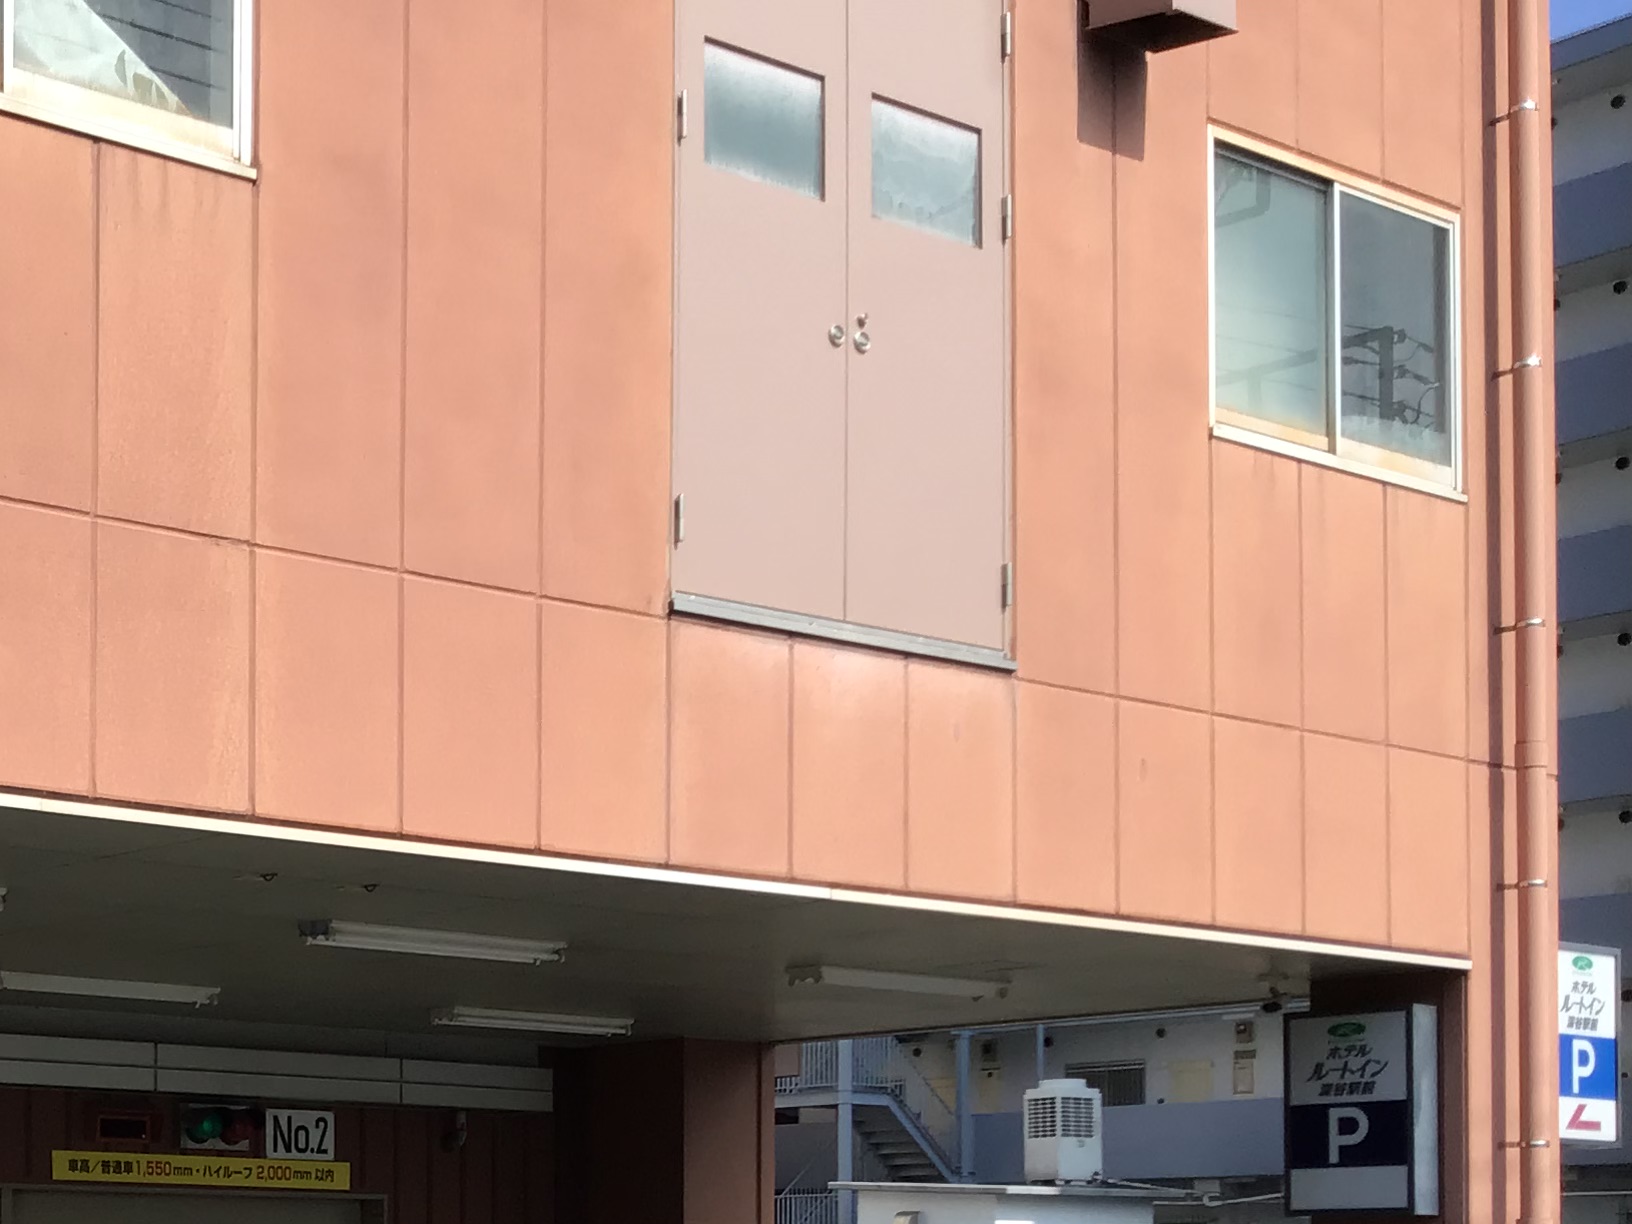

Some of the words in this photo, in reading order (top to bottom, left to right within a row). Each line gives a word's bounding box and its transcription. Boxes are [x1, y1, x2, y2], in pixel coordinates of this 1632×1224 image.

[1571, 980, 1597, 995] ホテル
[1560, 993, 1606, 1016] ルートイン
[1326, 1043, 1372, 1060] ホテル
[1305, 1058, 1389, 1083] ルートイン
[1572, 1038, 1596, 1094] P
[273, 1114, 329, 1155] No.2
[1328, 1106, 1370, 1165] P
